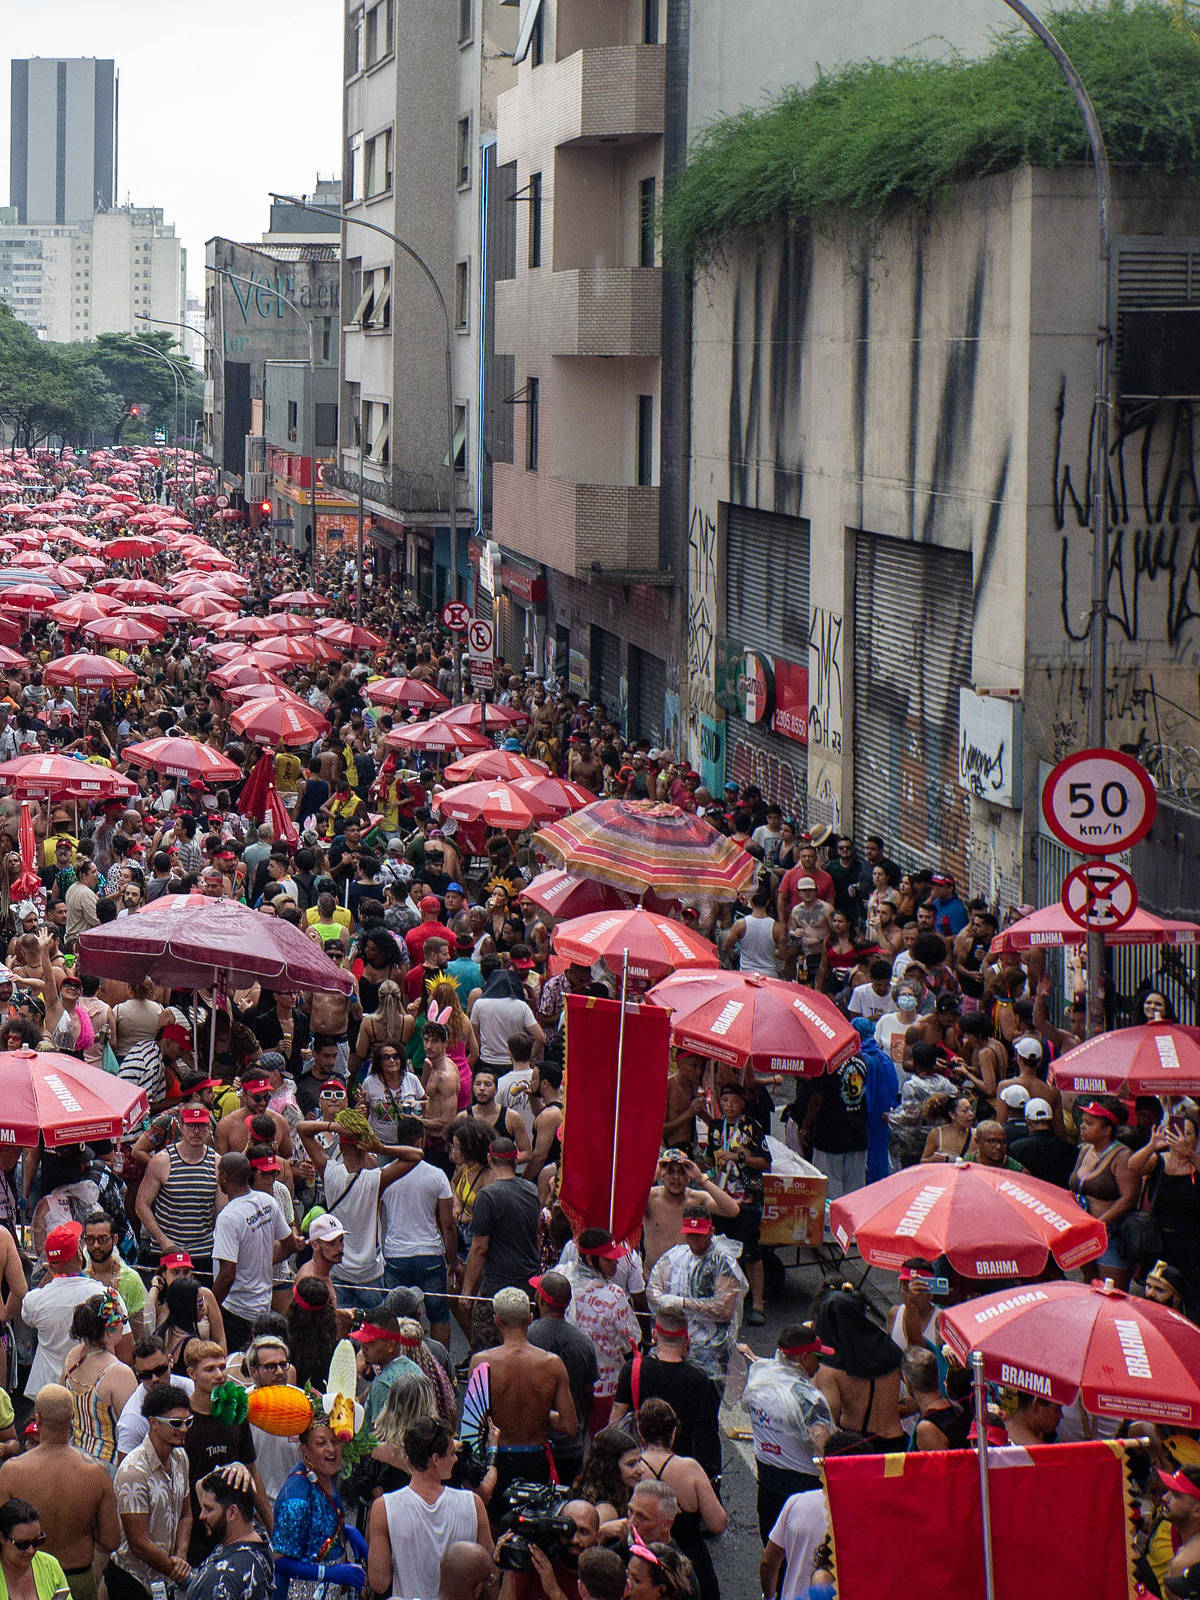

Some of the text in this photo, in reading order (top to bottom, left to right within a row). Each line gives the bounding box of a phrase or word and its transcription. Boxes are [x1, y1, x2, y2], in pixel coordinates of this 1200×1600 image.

[1068, 781, 1128, 818] 50
[1079, 823, 1122, 836] km/h
[657, 923, 697, 960] BRAHMA
[1030, 931, 1064, 945] BRAHMA
[627, 967, 650, 978] RAHMA
[710, 999, 746, 1036] BRAHMA
[792, 998, 837, 1039] BRAHMA
[771, 1058, 804, 1072] BRAHMA
[43, 1073, 83, 1113] BRAHMA
[1073, 1077, 1108, 1092] BRAHMA
[895, 1185, 947, 1238] BRAHMA
[999, 1180, 1073, 1232] BRAHMA
[974, 1259, 1019, 1275] BRAHMA
[974, 1289, 1049, 1324] BRAHMA
[1113, 1318, 1153, 1379] BRAHMA
[1001, 1362, 1053, 1397] BRAHMA
